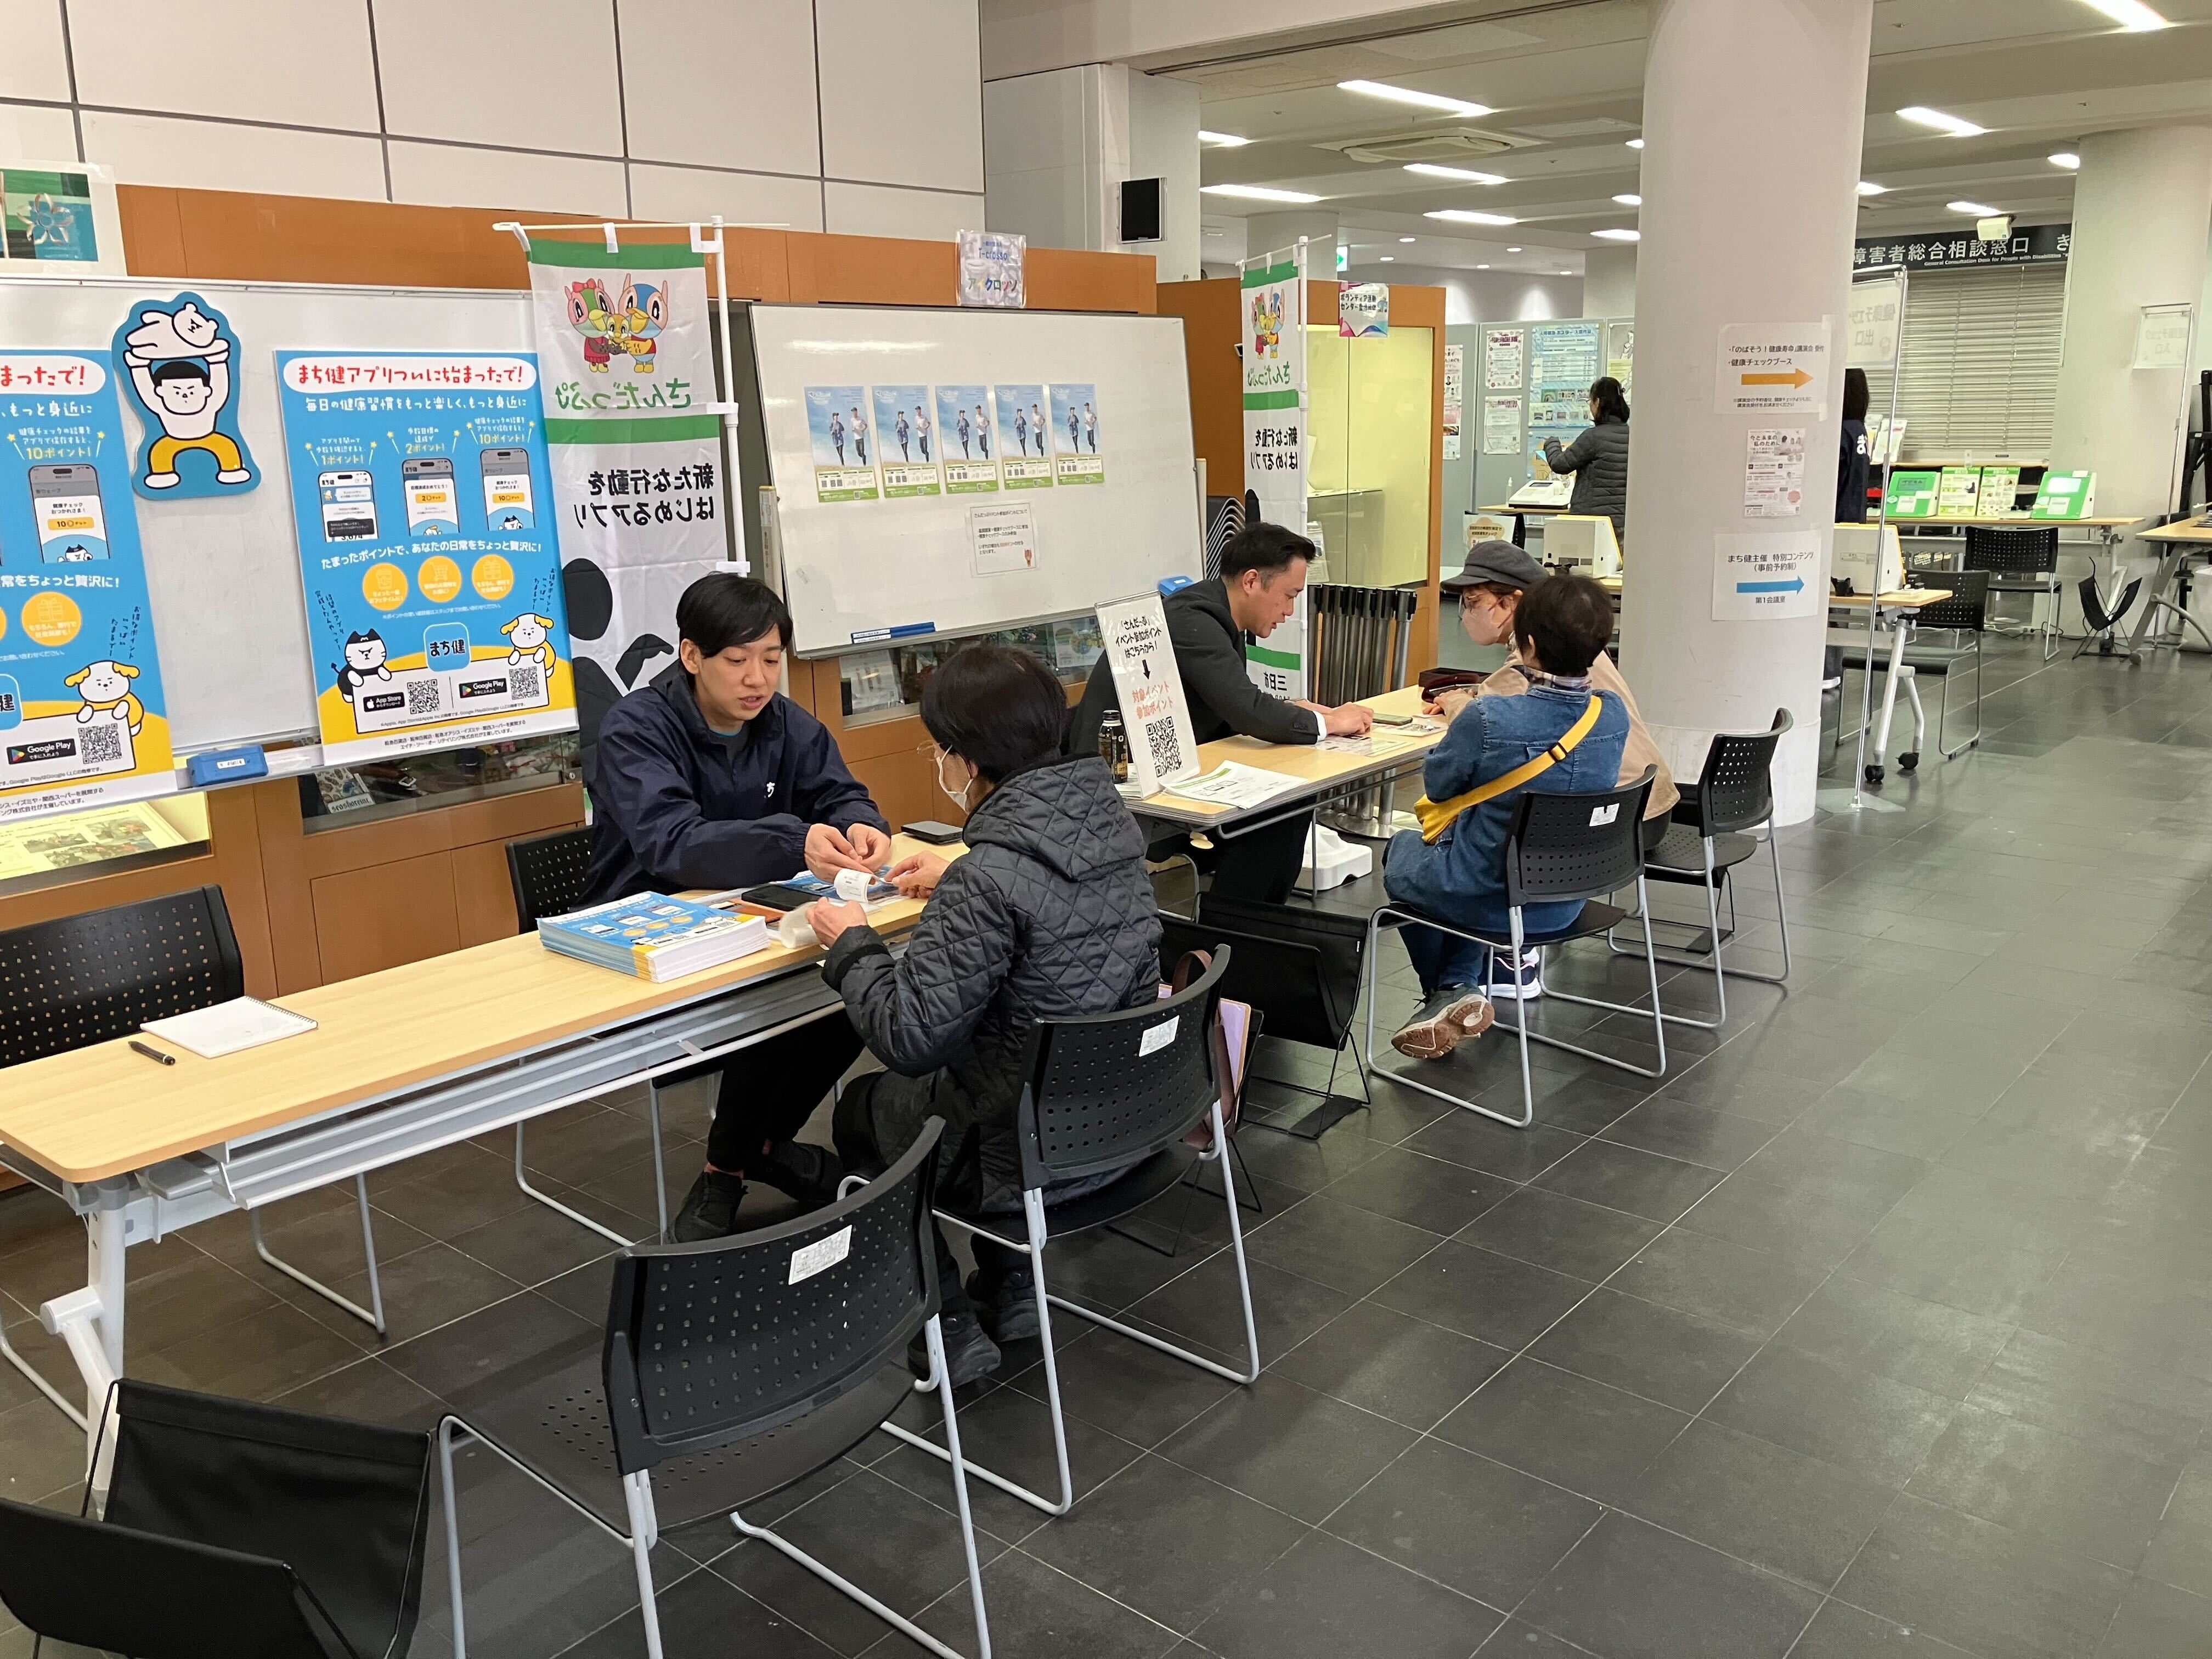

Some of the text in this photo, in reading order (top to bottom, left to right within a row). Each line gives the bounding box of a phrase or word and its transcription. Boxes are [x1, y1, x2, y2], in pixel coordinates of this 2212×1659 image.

[1854, 237, 2029, 264] 障害者総合相談窓口
[298, 364, 523, 385] まち健アプリついに始まったで!
[306, 394, 527, 412] 毎日の健康習慣をもっと楽しく、もっと身近に
[0, 574, 119, 588] 常をちょっと贅沢に!
[430, 639, 465, 657] まち健
[473, 682, 492, 691] Google
[27, 742, 71, 754] Google Play
